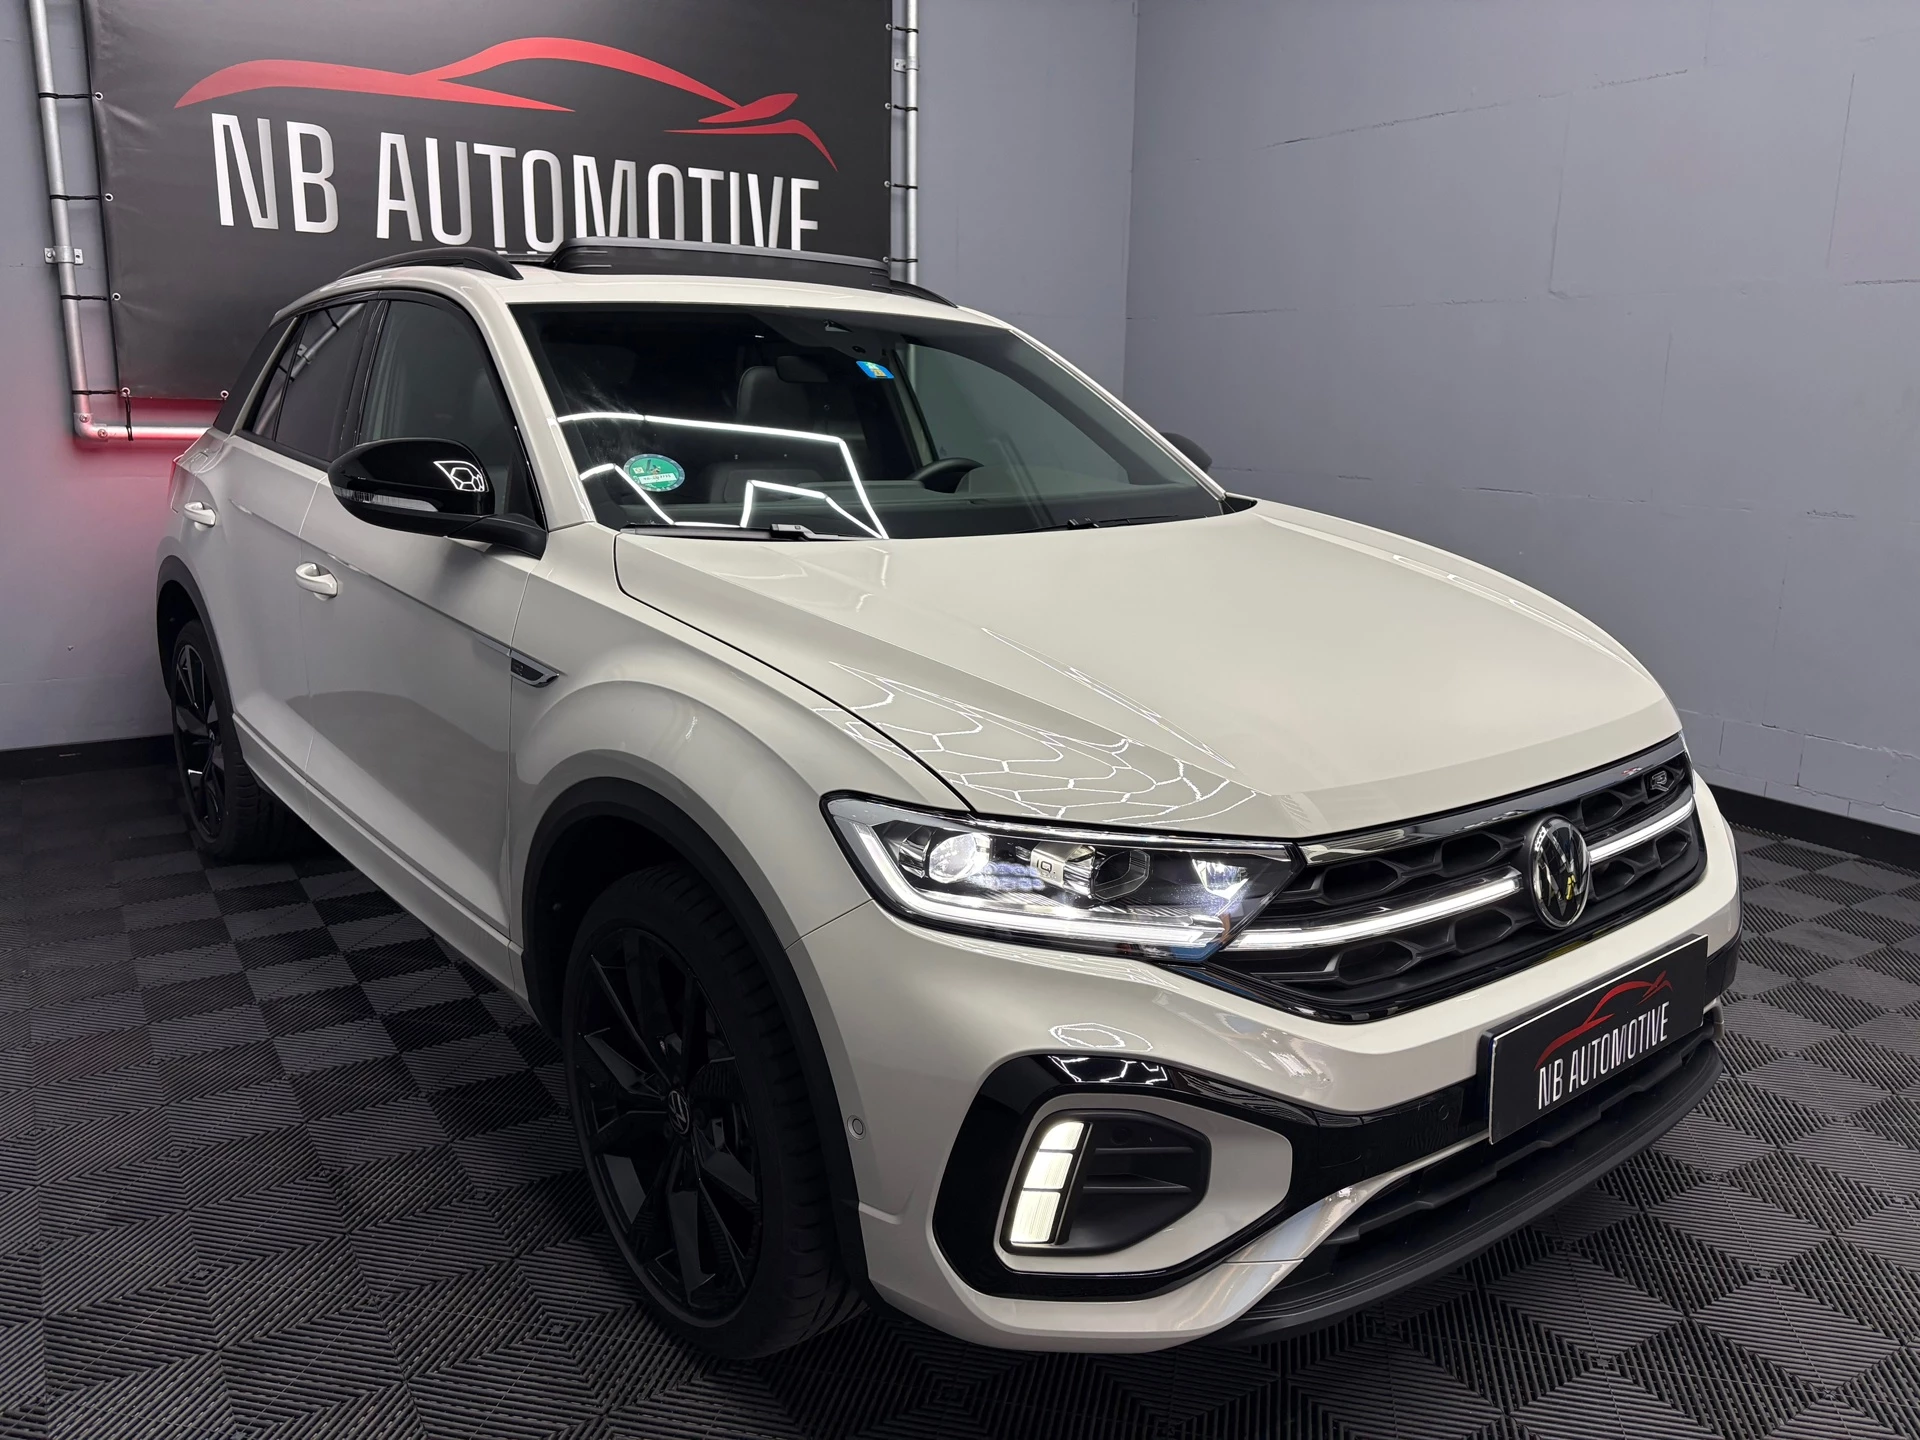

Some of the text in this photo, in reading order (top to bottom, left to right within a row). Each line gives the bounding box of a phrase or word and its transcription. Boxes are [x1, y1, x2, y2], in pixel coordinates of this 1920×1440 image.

[211, 112, 820, 253] NB AUTOMOTIVE
[1538, 1001, 1670, 1110] NB AUTOMOTIVE
